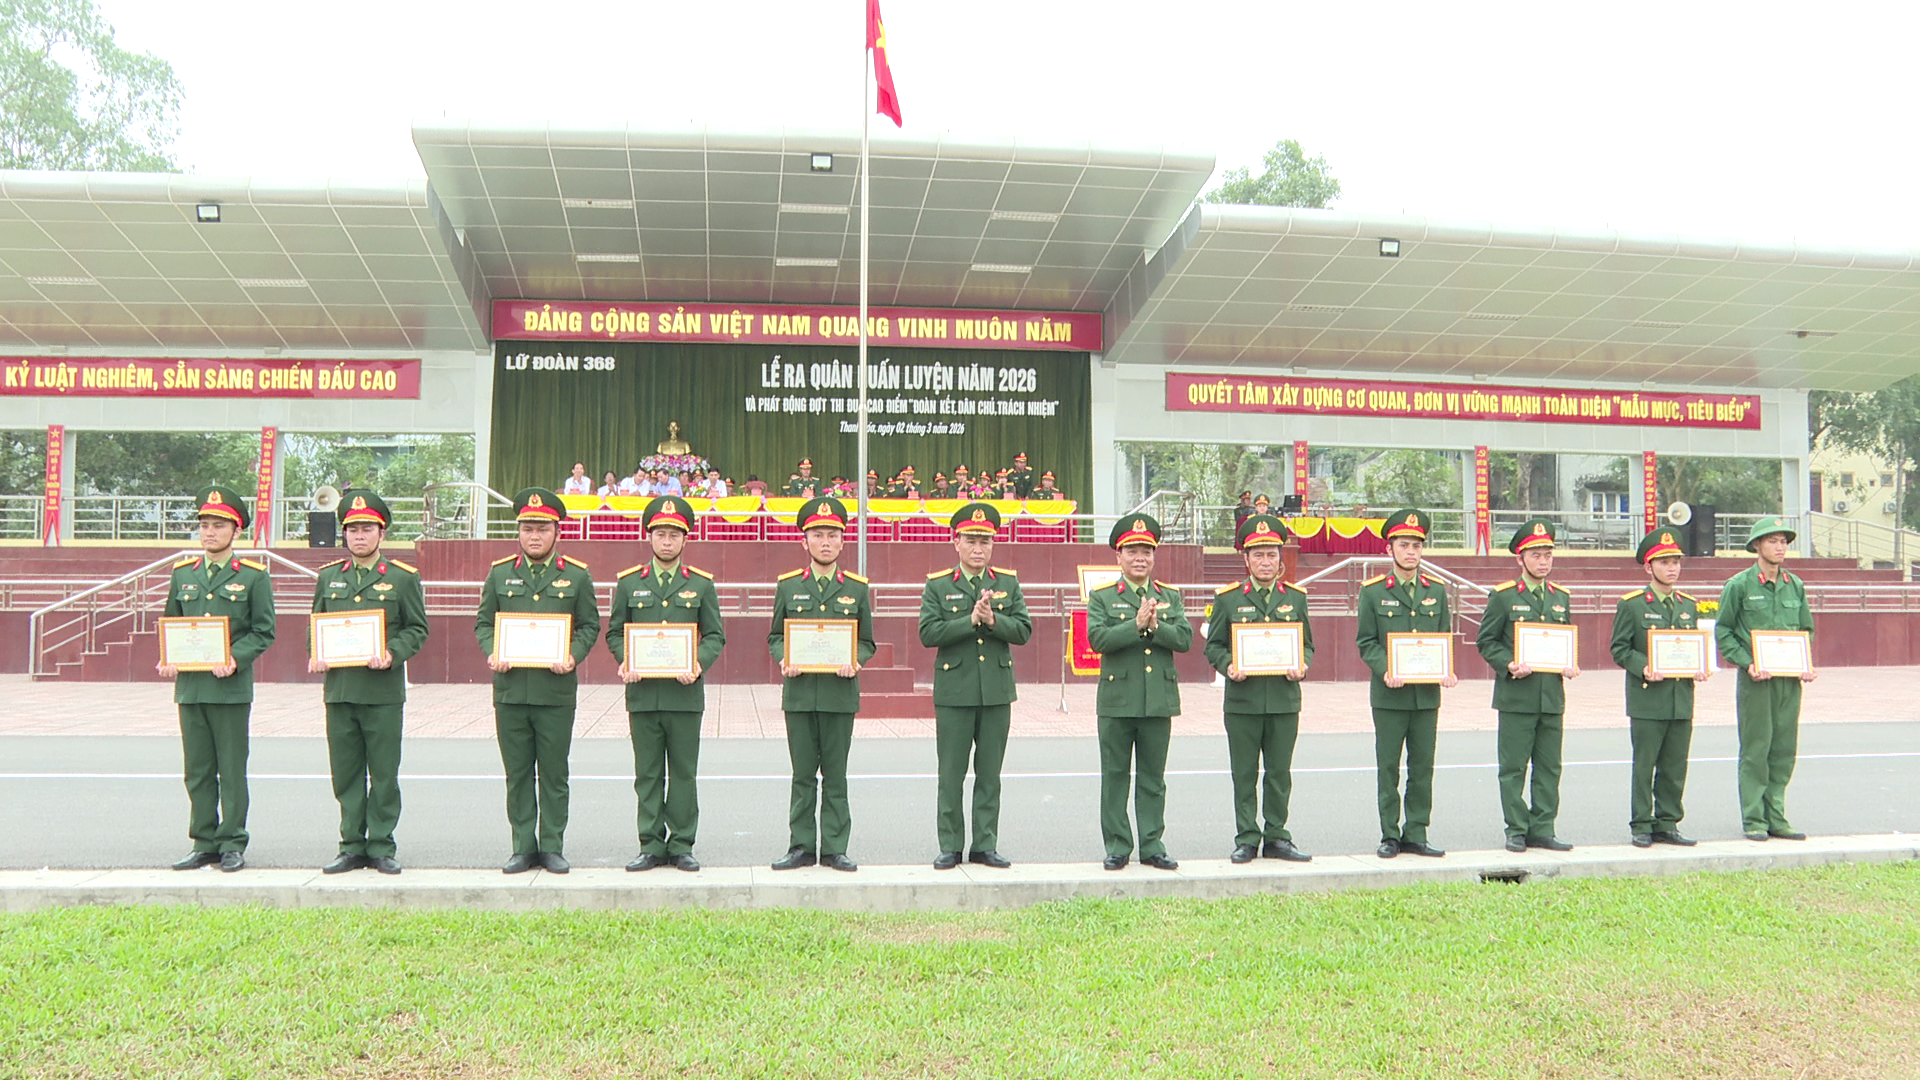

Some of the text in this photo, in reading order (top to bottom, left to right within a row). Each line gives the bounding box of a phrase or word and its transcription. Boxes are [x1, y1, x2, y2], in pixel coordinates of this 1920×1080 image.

[524, 304, 1072, 342] ĐẢNG CỘNG SẢN VIỆT NAM QUANG VINH MUÔN NĂM
[5, 360, 397, 392] KỶ LUẬT NGHIÊM, SẴN SÀNG CHIẾN ĐẤU CAO
[505, 352, 616, 371] LỮ ĐOÀN 368
[761, 354, 782, 388] LỄ
[784, 363, 806, 388] RA
[810, 358, 853, 391] QUÂN
[904, 361, 953, 395] LUYỆN
[958, 363, 994, 391] NĂM
[999, 367, 1037, 393] 2026
[745, 395, 756, 412] VÀ
[758, 395, 780, 412] PHÁT
[782, 394, 807, 415] ĐỘNG
[809, 397, 827, 416] ĐỢT
[830, 398, 844, 413] THI
[847, 398, 863, 413] ĐU
[866, 398, 884, 414] CAO
[886, 393, 908, 414] ĐIỂM
[1188, 378, 1234, 405] QUYẾT
[1237, 382, 1268, 405] TÂM
[1272, 383, 1299, 406] XÂY
[1303, 386, 1343, 411] DỰNG
[1346, 388, 1366, 408] CƠ
[1369, 390, 1412, 413] QUAN,
[1413, 390, 1443, 412] ĐƠN
[1446, 393, 1460, 416] VỊ
[1462, 390, 1499, 414] VỮNG
[1502, 395, 1541, 418] MẠNH
[1544, 394, 1578, 416] TOÀN
[1581, 395, 1611, 419] DIỆN
[1651, 399, 1685, 422] MỰC,
[1686, 399, 1714, 420] TIÊU
[839, 420, 859, 433] Than
[877, 422, 896, 437] ngày
[895, 421, 906, 434] 02
[905, 421, 927, 437] tháng
[926, 421, 933, 434] 3
[932, 421, 949, 434] năm
[948, 422, 966, 435] 2026
